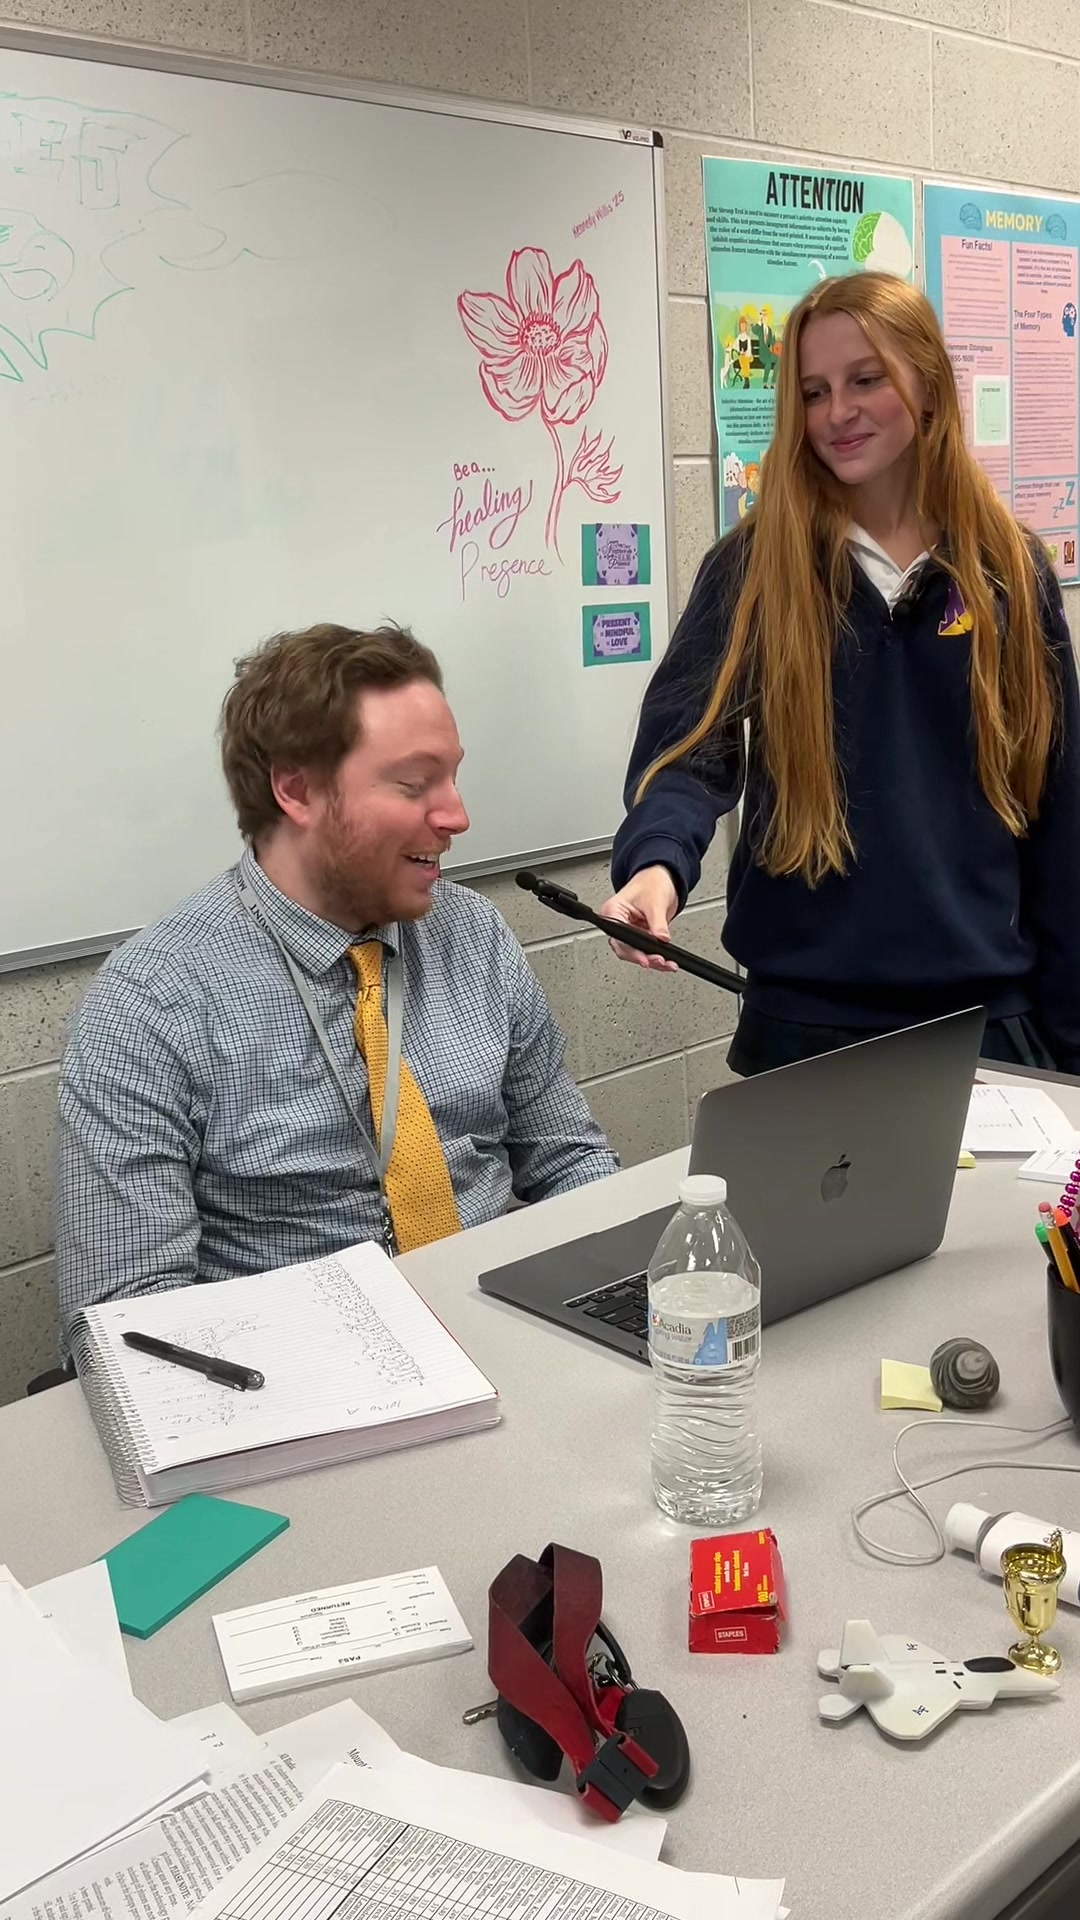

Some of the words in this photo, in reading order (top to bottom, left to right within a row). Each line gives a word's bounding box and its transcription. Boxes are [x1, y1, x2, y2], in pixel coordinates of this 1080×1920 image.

[766, 172, 864, 213] ATTENTION
[985, 209, 1044, 233] MEMORY
[961, 239, 973, 250] Fun
[974, 240, 993, 251] Facts!
[1014, 310, 1024, 318] The
[1024, 310, 1036, 319] Four
[1037, 311, 1052, 321] Types
[1013, 322, 1019, 330] of
[1020, 323, 1041, 333] Memory
[453, 462, 470, 481] Be
[436, 478, 533, 553] healing
[461, 541, 553, 602] Presence
[601, 617, 631, 628] PRESENT
[605, 627, 635, 638] MINDFUL
[611, 637, 628, 647] LOVE
[659, 1318, 692, 1335] Acadia
[310, 1600, 350, 1612] RETURNED
[717, 1630, 744, 1639] STAPLES
[337, 1805, 351, 1816] Mail
[324, 1817, 340, 1830] Room
[338, 1829, 353, 1842] Room
[351, 1828, 367, 1841] Room
[168, 1865, 183, 1883] PLEASE
[176, 1880, 191, 1899] NOTE:
